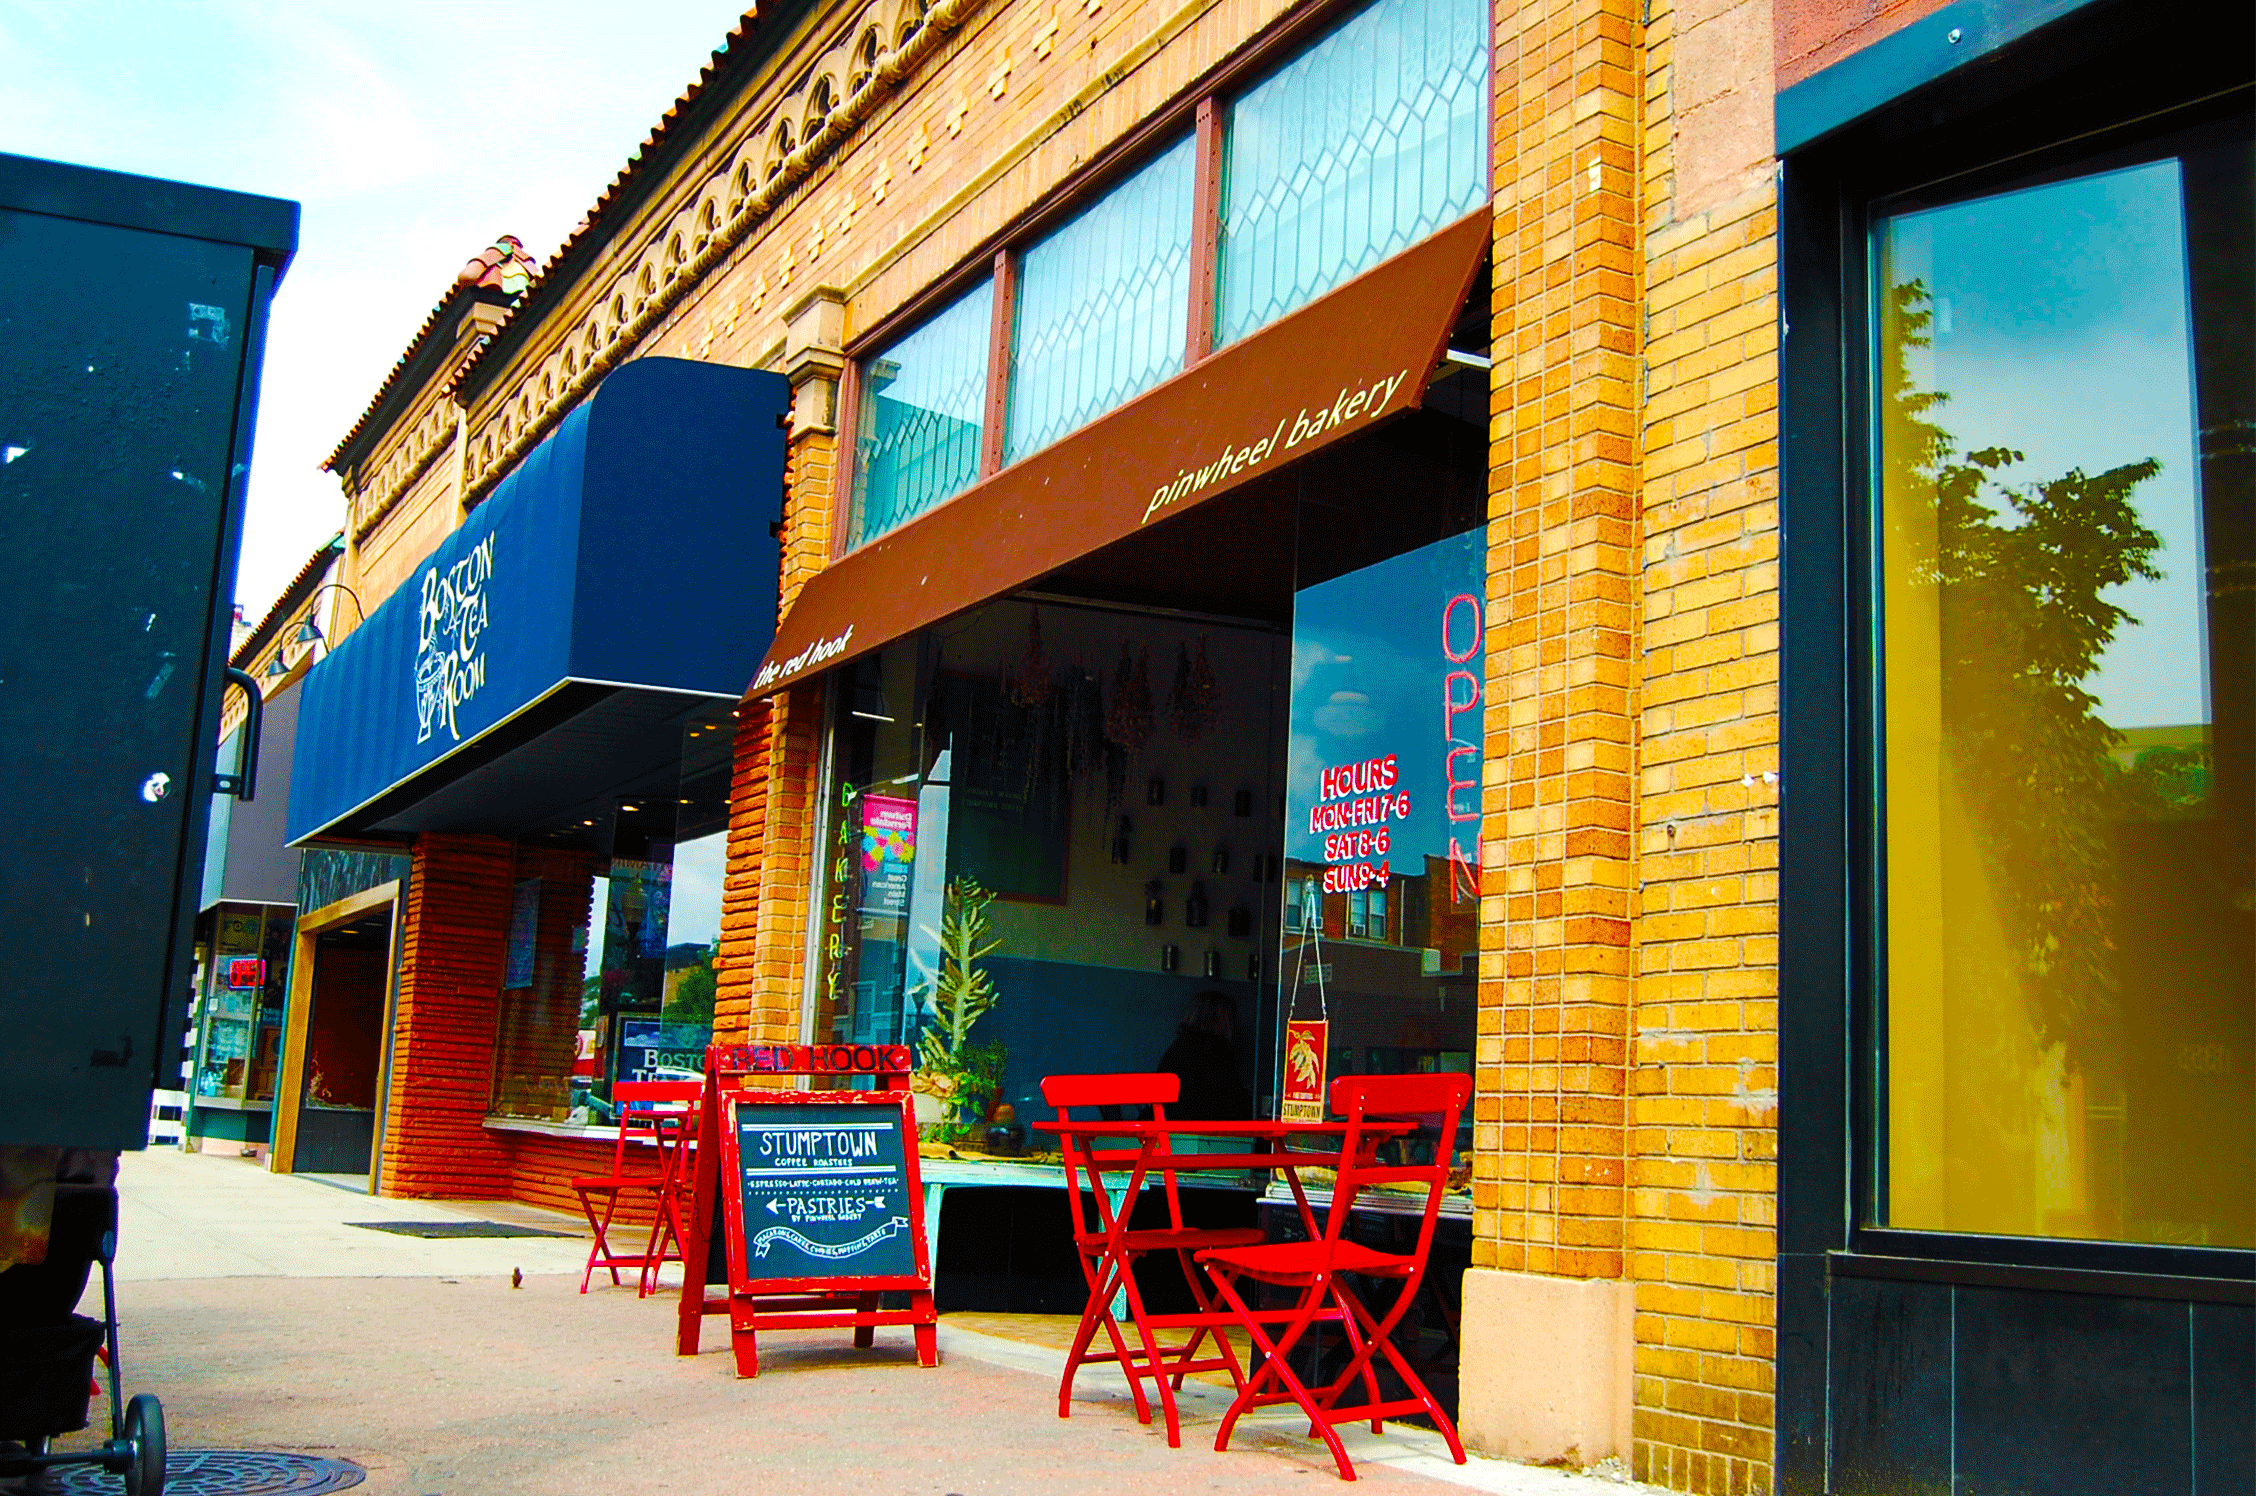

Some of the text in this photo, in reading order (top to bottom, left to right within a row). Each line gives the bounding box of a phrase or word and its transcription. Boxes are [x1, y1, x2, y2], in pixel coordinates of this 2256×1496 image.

[1141, 369, 1408, 525] pinwheel bakery
[419, 530, 495, 655] BOSTON
[455, 583, 489, 662] TEA
[753, 624, 854, 690] the red hook
[439, 650, 486, 741] ROOM
[1442, 592, 1483, 902] OPEN
[1320, 752, 1399, 802] HOURS
[828, 782, 854, 1000] BAKERY
[643, 1049, 706, 1070] BOSTO
[732, 1046, 898, 1072] RED HOOK
[1283, 1103, 1321, 1118] STUMPTOWN
[759, 1131, 878, 1157] STUMPTOWN
[774, 1157, 853, 1167] COFFEE ROASTERS
[786, 1196, 866, 1215] PASTRIES
